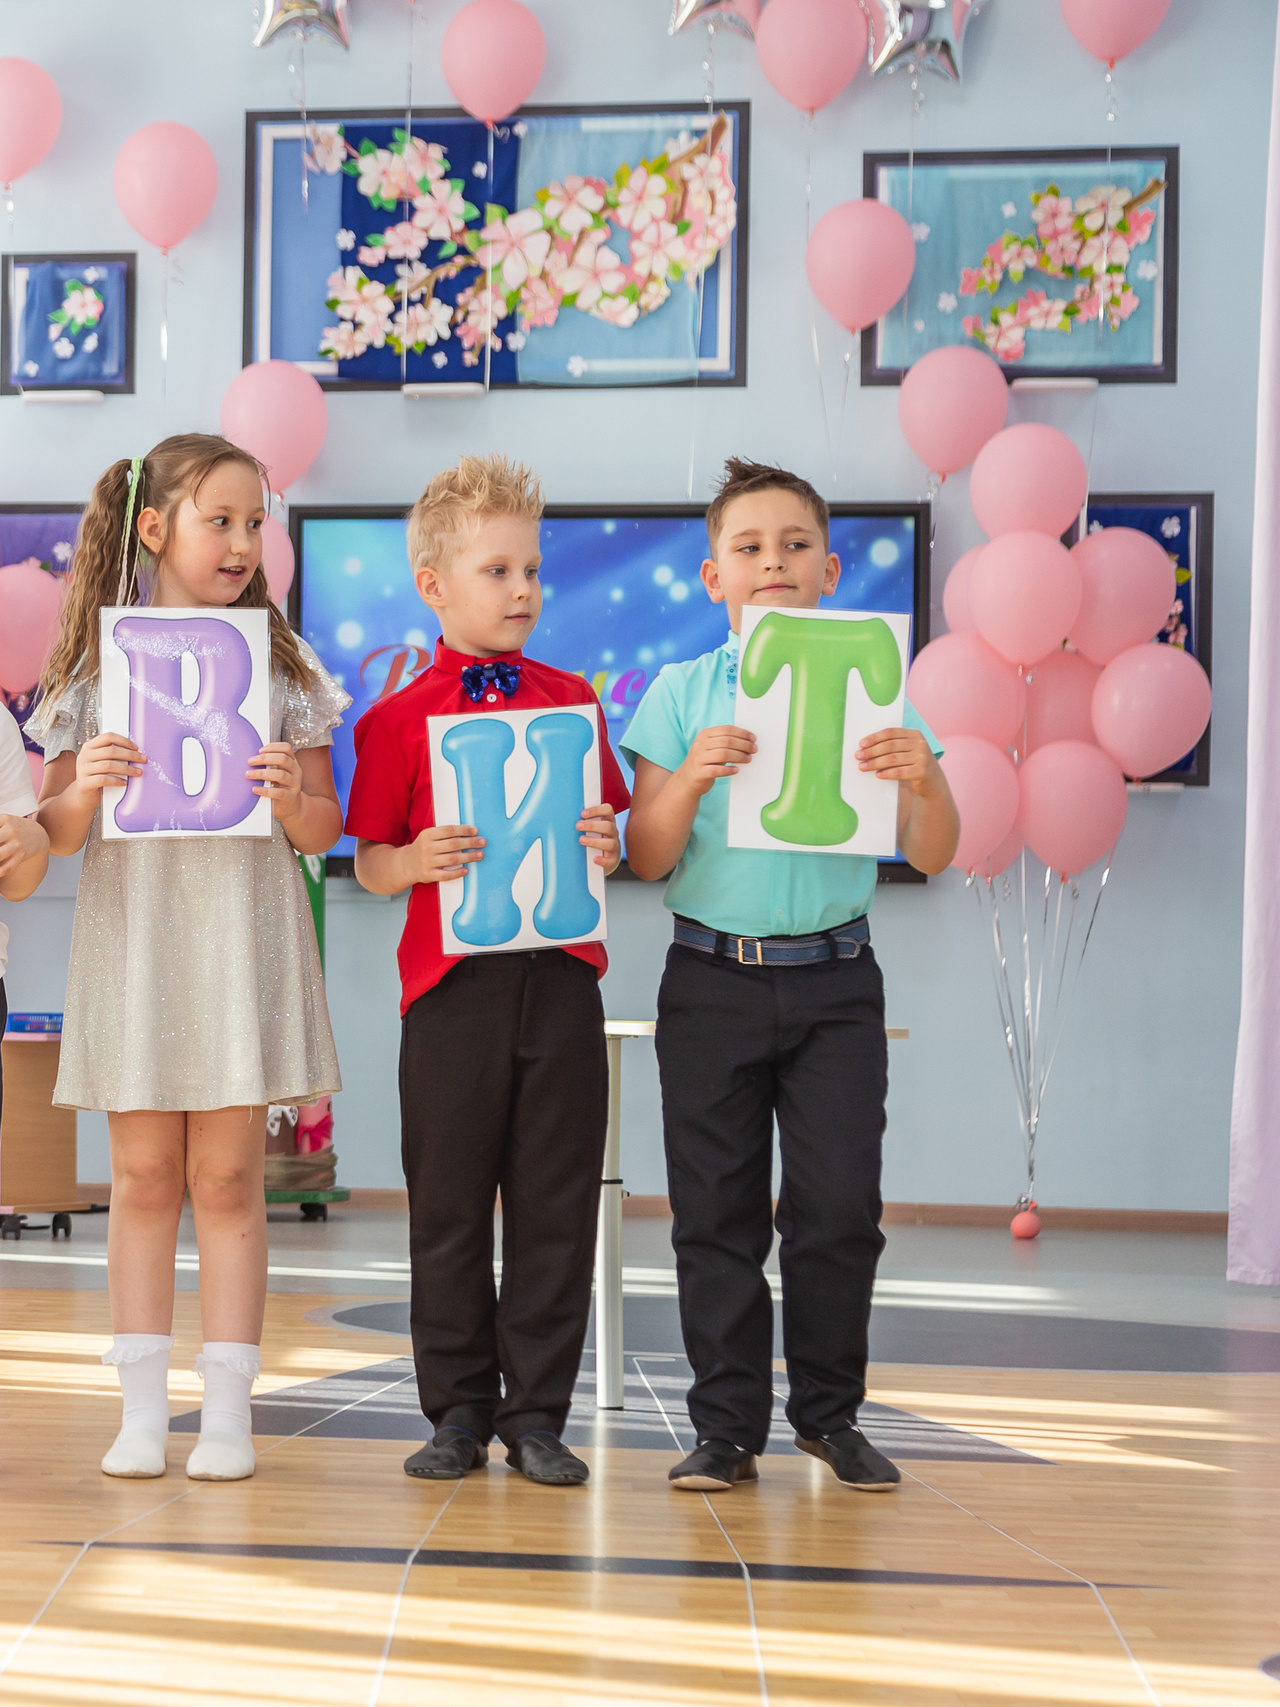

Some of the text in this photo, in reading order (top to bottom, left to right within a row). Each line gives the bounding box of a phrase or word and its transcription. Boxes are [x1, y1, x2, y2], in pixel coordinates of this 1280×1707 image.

[113, 616, 263, 833] В
[441, 712, 600, 946] И
[741, 611, 902, 846] Т
